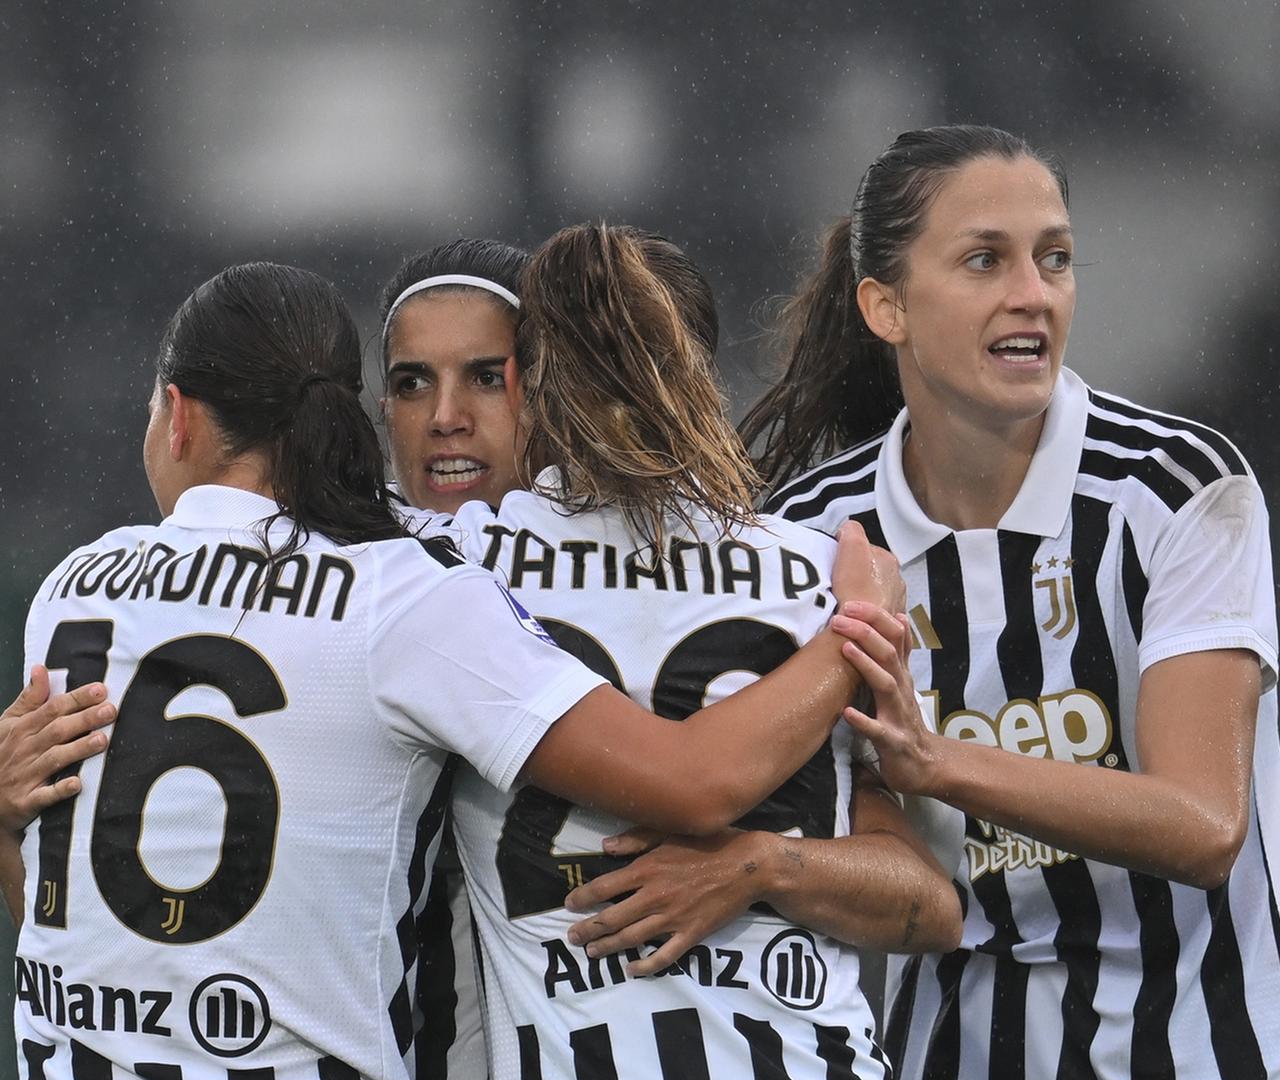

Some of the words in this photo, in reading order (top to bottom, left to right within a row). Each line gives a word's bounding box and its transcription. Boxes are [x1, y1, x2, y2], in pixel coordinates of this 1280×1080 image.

[48, 540, 359, 622] NOORDMAN
[482, 524, 762, 600] TATIANA
[779, 545, 827, 608] P.
[34, 617, 289, 945] 16
[964, 834, 1081, 883] Detro
[15, 956, 173, 1037] Allianz
